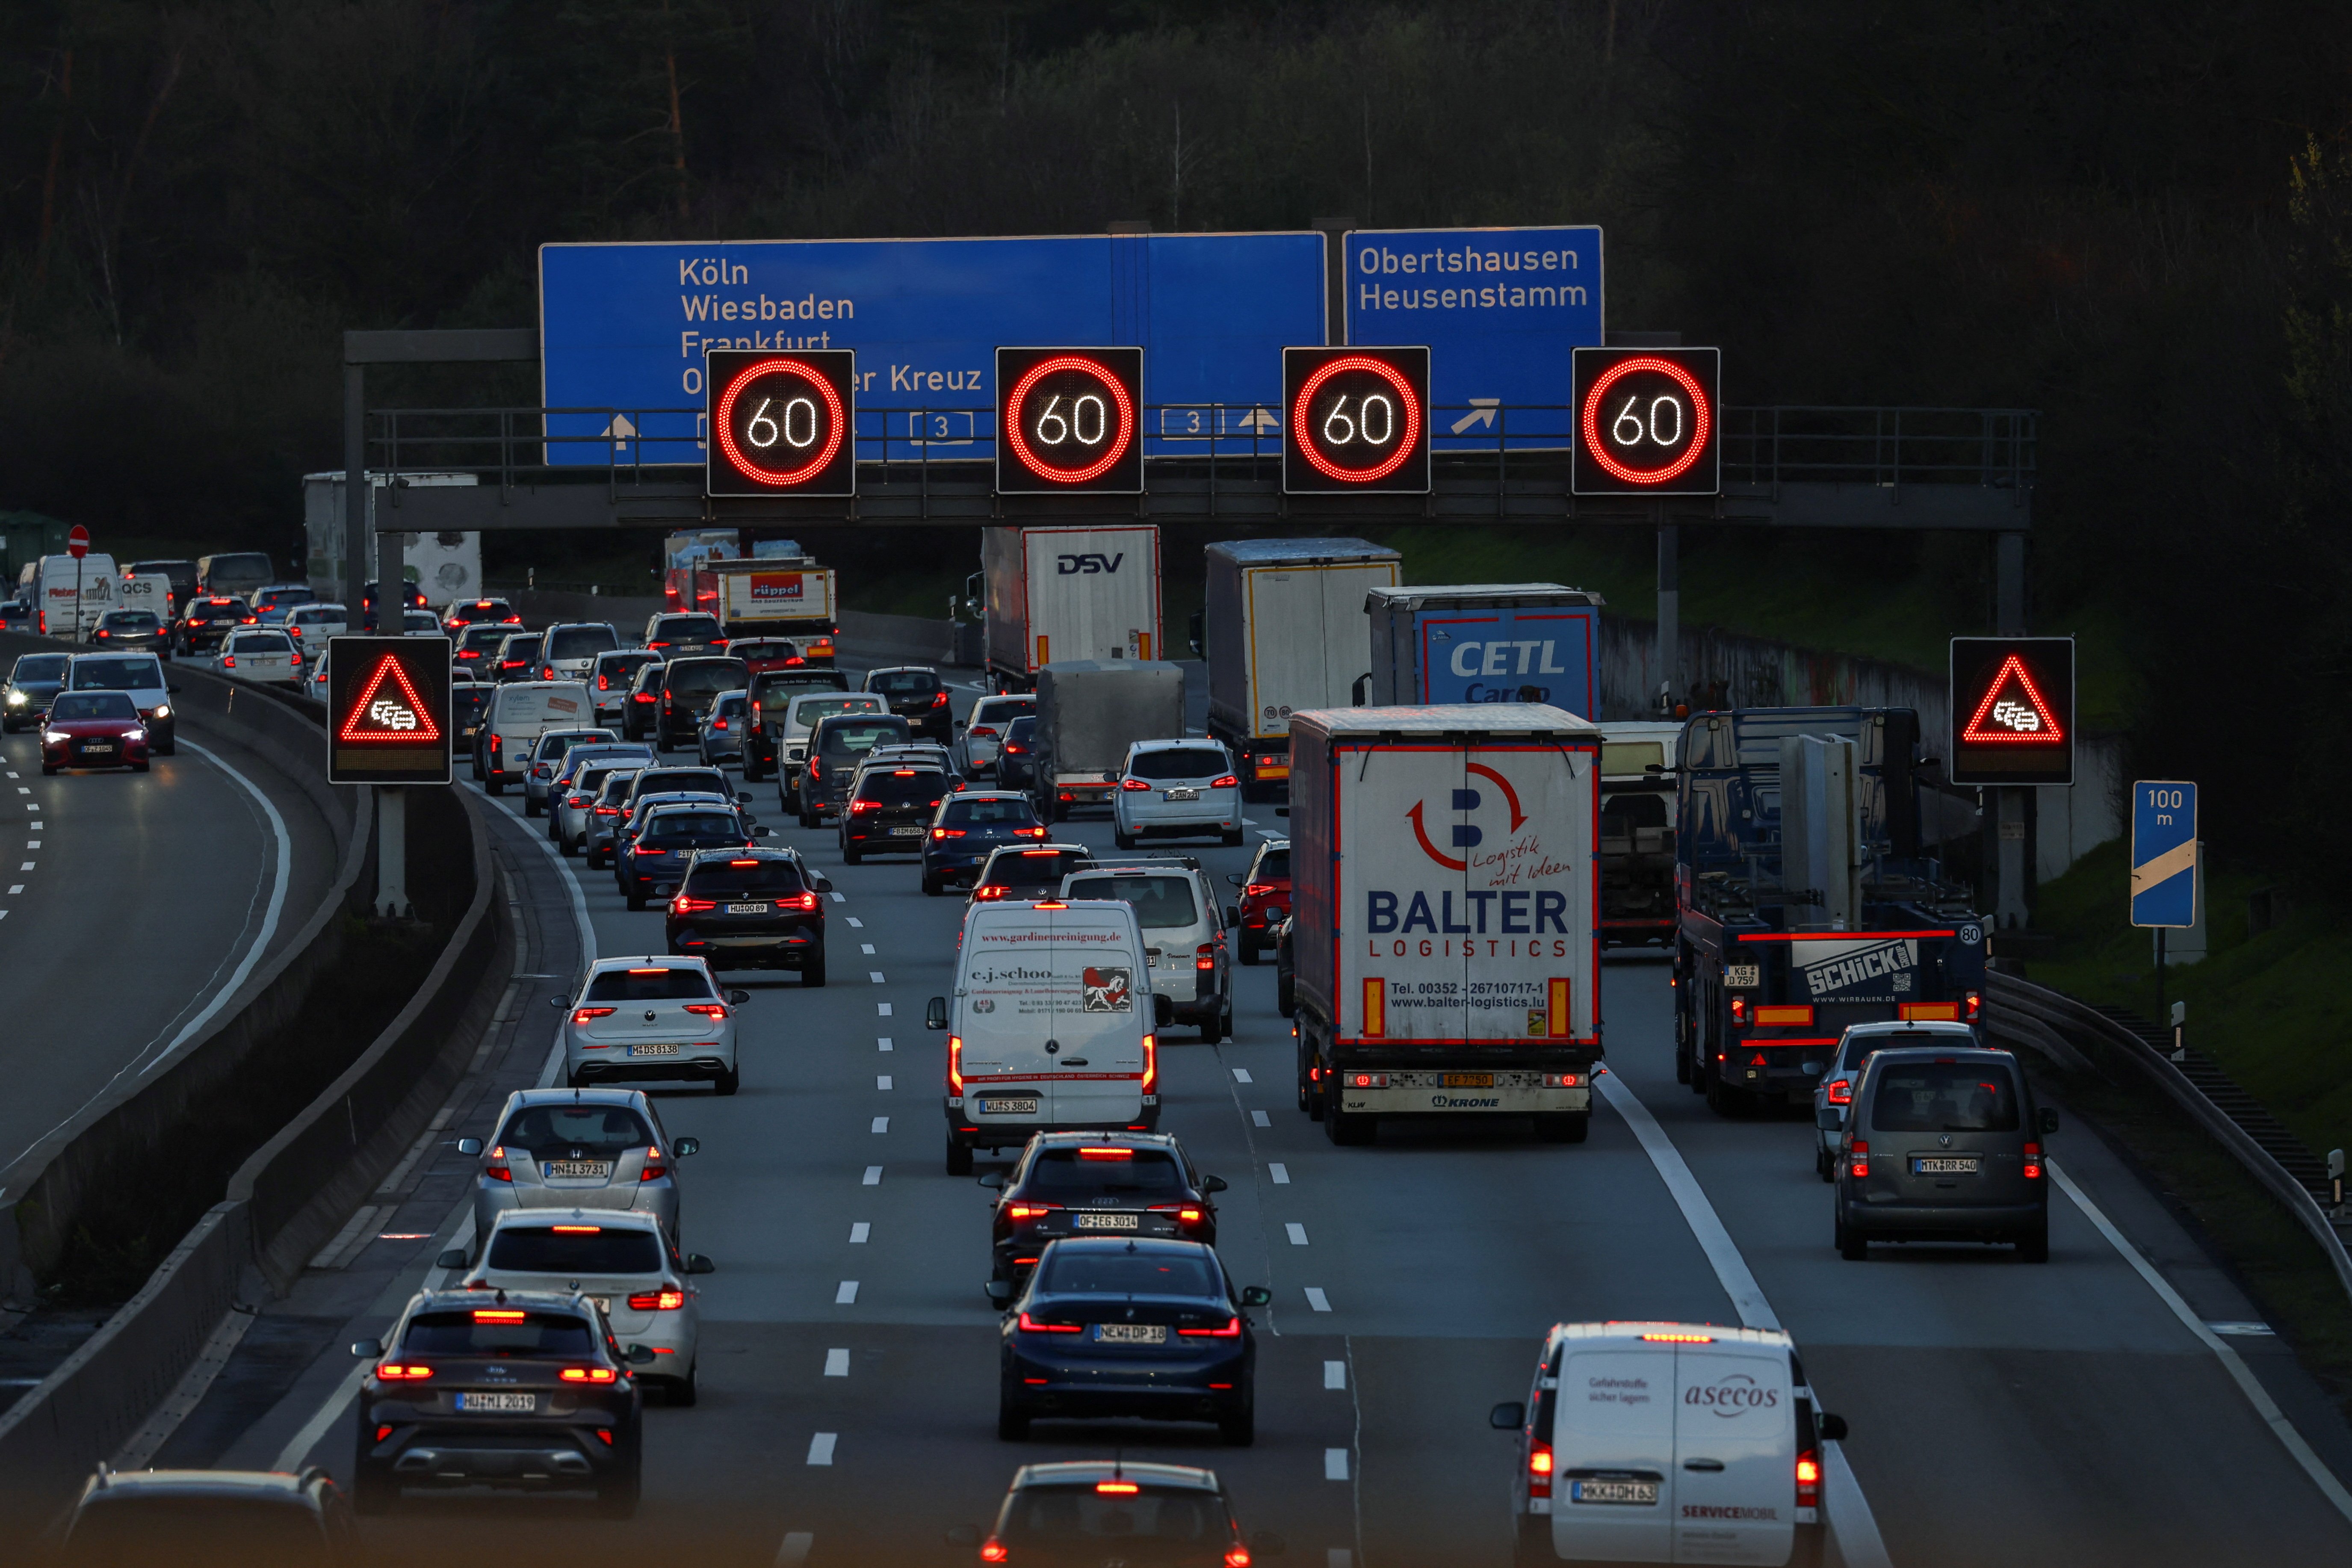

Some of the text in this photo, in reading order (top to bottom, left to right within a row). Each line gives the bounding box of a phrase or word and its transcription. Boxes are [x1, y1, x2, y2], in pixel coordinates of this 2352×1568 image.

[1360, 246, 1578, 274] Obertshausen
[680, 258, 748, 285] Köln
[1361, 283, 1587, 310] Heusenstamm
[681, 293, 854, 321] Wiesbaden
[682, 331, 830, 358] Frankfurt
[891, 365, 981, 391] Kreuz
[747, 397, 816, 448] 60
[935, 416, 948, 437] 3
[1037, 395, 1105, 445] 60
[1186, 411, 1200, 433] 3
[1324, 395, 1392, 445] 60
[1613, 396, 1681, 446] 60
[1058, 553, 1124, 575] DSV
[121, 582, 152, 594] QCS
[753, 584, 800, 596] rüppel
[1450, 640, 1566, 677] CETL
[509, 694, 530, 703] xylem
[1465, 682, 1551, 704] Caro
[2148, 789, 2182, 809] 100
[2157, 814, 2172, 826] m
[1472, 835, 1539, 877] Logistik
[1489, 856, 1571, 886] mit Ideen
[1367, 891, 1569, 934] BALTER
[981, 932, 1122, 945] www.gardinenreinigung.de
[1962, 928, 1978, 941] 80
[1370, 940, 1566, 957] LOGISTICS
[1895, 945, 1911, 968] GROUP
[1734, 967, 1746, 976] KG
[1391, 983, 1414, 994] Tel.
[1418, 983, 1457, 994] 00352
[1470, 983, 1543, 994] 26710717-1
[1729, 976, 1754, 985] D 759
[1391, 996, 1544, 1010] www.balter-logistics.lu
[633, 1045, 677, 1054] M DS 8138
[1448, 1075, 1460, 1084] EF
[986, 1101, 1034, 1110] WU S 3804
[1448, 1098, 1500, 1107] KRONE
[552, 1163, 565, 1174] HN
[579, 1163, 604, 1174] 3731
[1921, 1160, 1976, 1171] MTK RR 540
[1079, 1215, 1137, 1226] OF EG 3014
[1100, 1326, 1124, 1339] NEW
[1132, 1326, 1148, 1340] DP
[464, 1395, 479, 1407] HU
[1685, 1386, 1778, 1408] asecos
[1582, 1485, 1607, 1498] MKK
[1617, 1485, 1635, 1499] DH
[1682, 1505, 1778, 1521] SERVICEMOBIL
